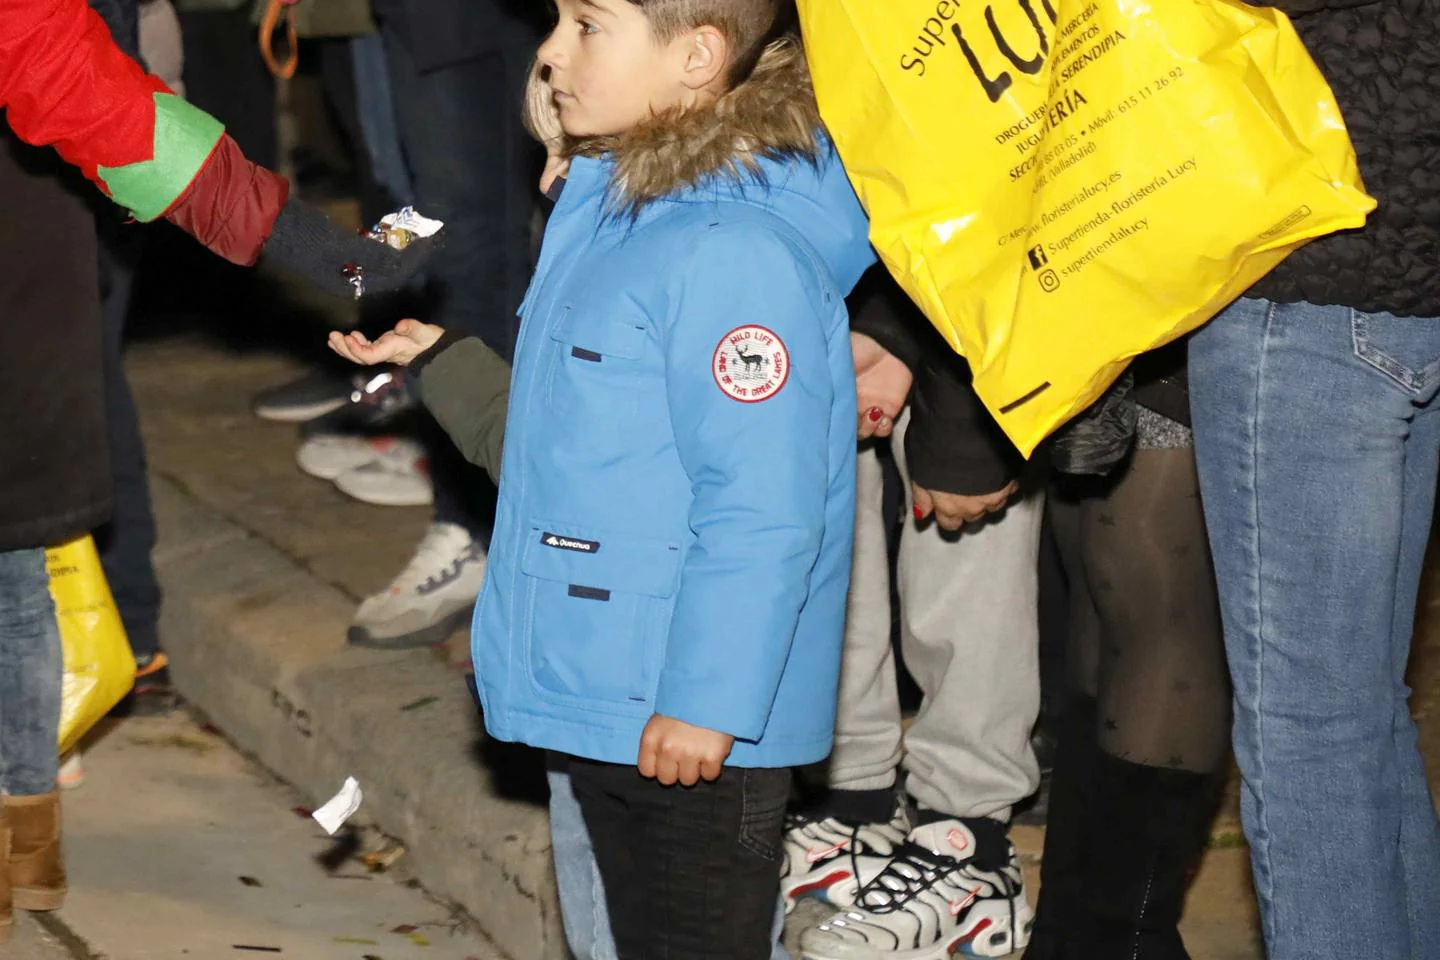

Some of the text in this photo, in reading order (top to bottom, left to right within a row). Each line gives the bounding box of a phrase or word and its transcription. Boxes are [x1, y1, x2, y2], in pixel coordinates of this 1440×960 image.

[1118, 95, 1138, 114] 615
[1138, 86, 1152, 99] 11
[1153, 75, 1169, 91] 26
[1169, 66, 1184, 81] 92
[1167, 156, 1198, 180] Lucy
[1060, 217, 1150, 277] supertiendalucy
[730, 331, 774, 346] WILD LIFE
[732, 384, 747, 396] THE
[751, 379, 775, 397] GREAT
[559, 538, 590, 551] Quechua
